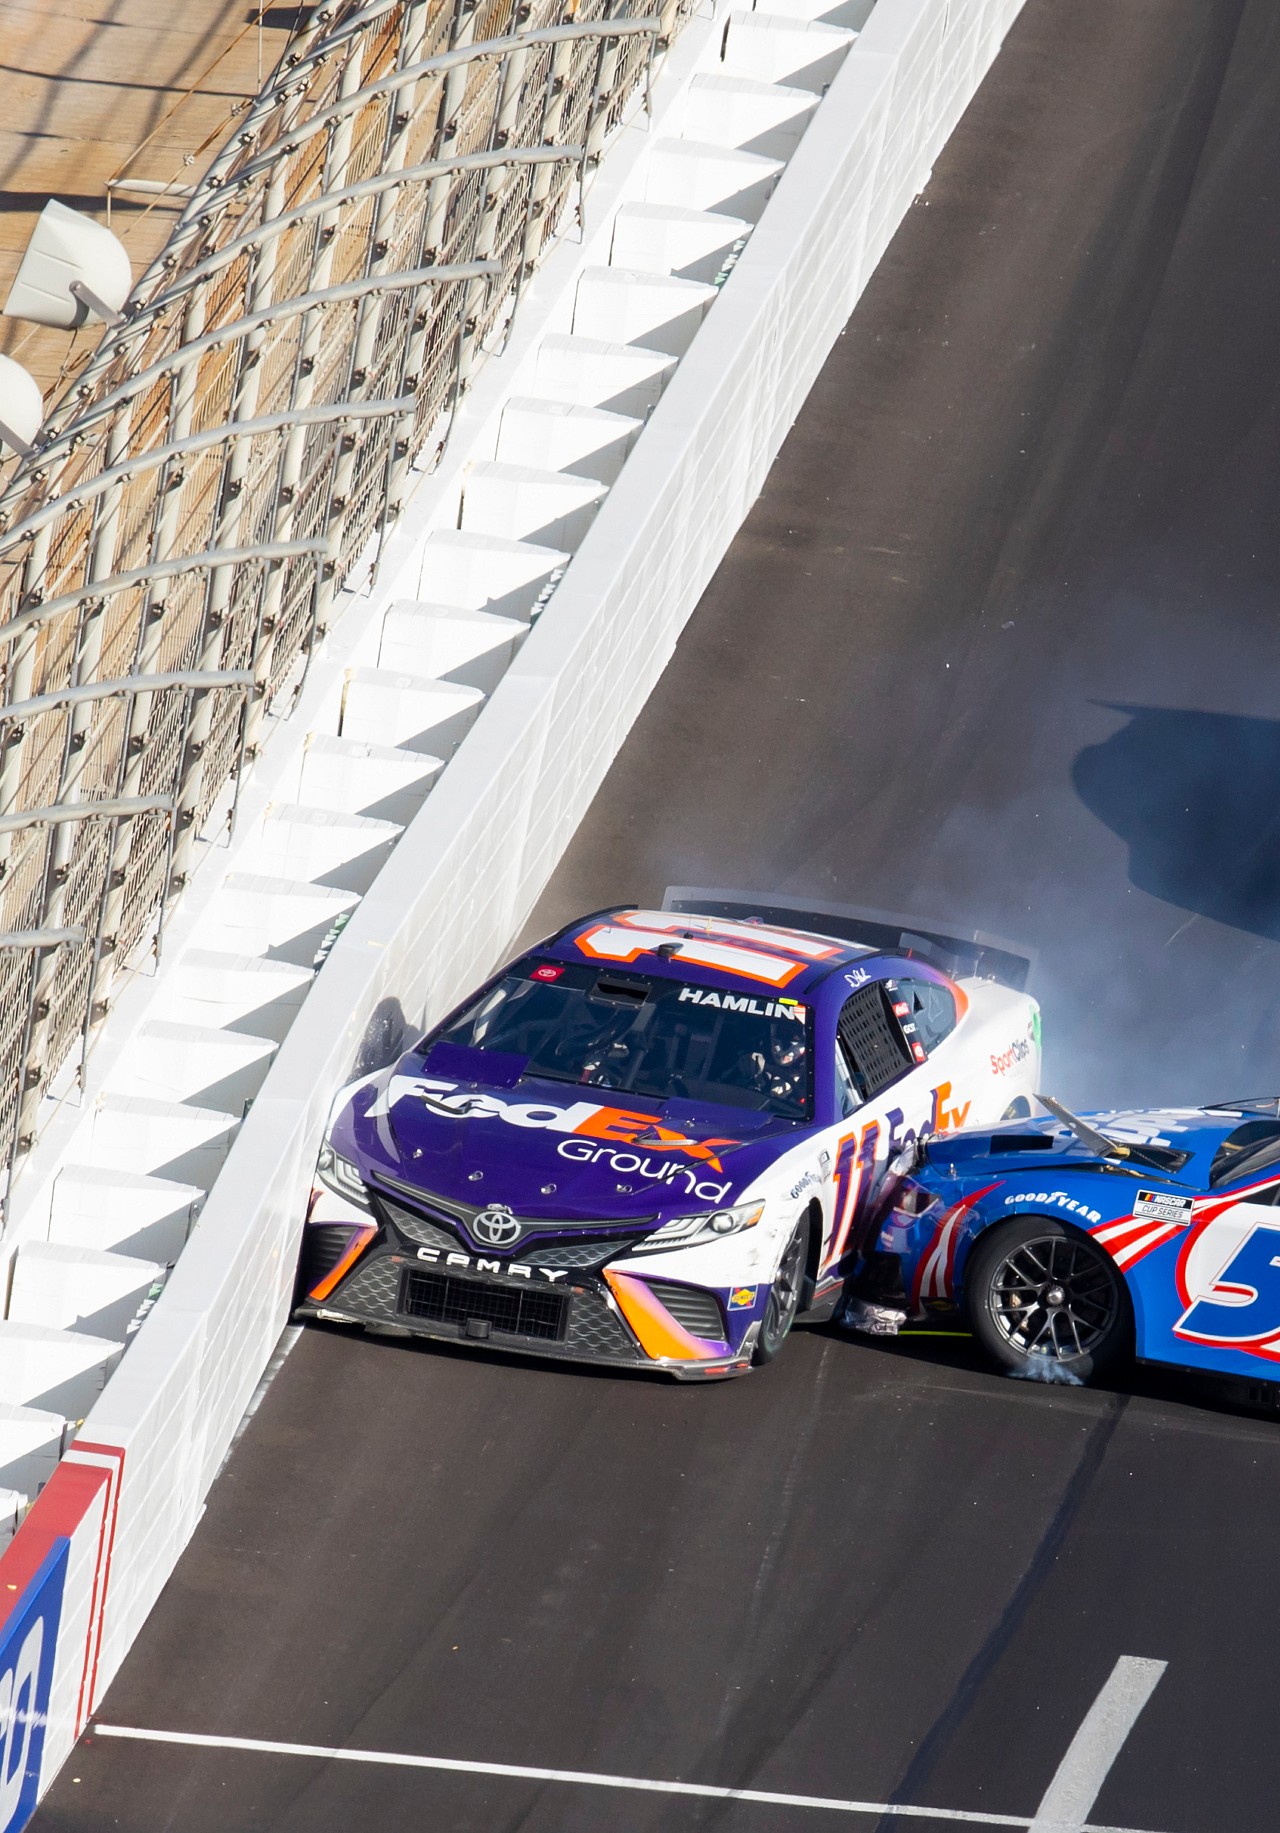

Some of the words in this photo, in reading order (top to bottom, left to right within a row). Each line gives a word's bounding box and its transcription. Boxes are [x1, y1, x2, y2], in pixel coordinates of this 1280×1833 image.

[678, 987, 796, 1020] HAMLIN
[365, 1074, 742, 1174] FedEx
[557, 1138, 732, 1205] Ground
[818, 1118, 881, 1281] 11
[1004, 1191, 1102, 1224] GOODYEAR
[1141, 1204, 1158, 1214] CUP
[1157, 1208, 1184, 1219] SERIES
[1154, 1195, 1186, 1208] NASCAR
[416, 1246, 569, 1283] CAMRY
